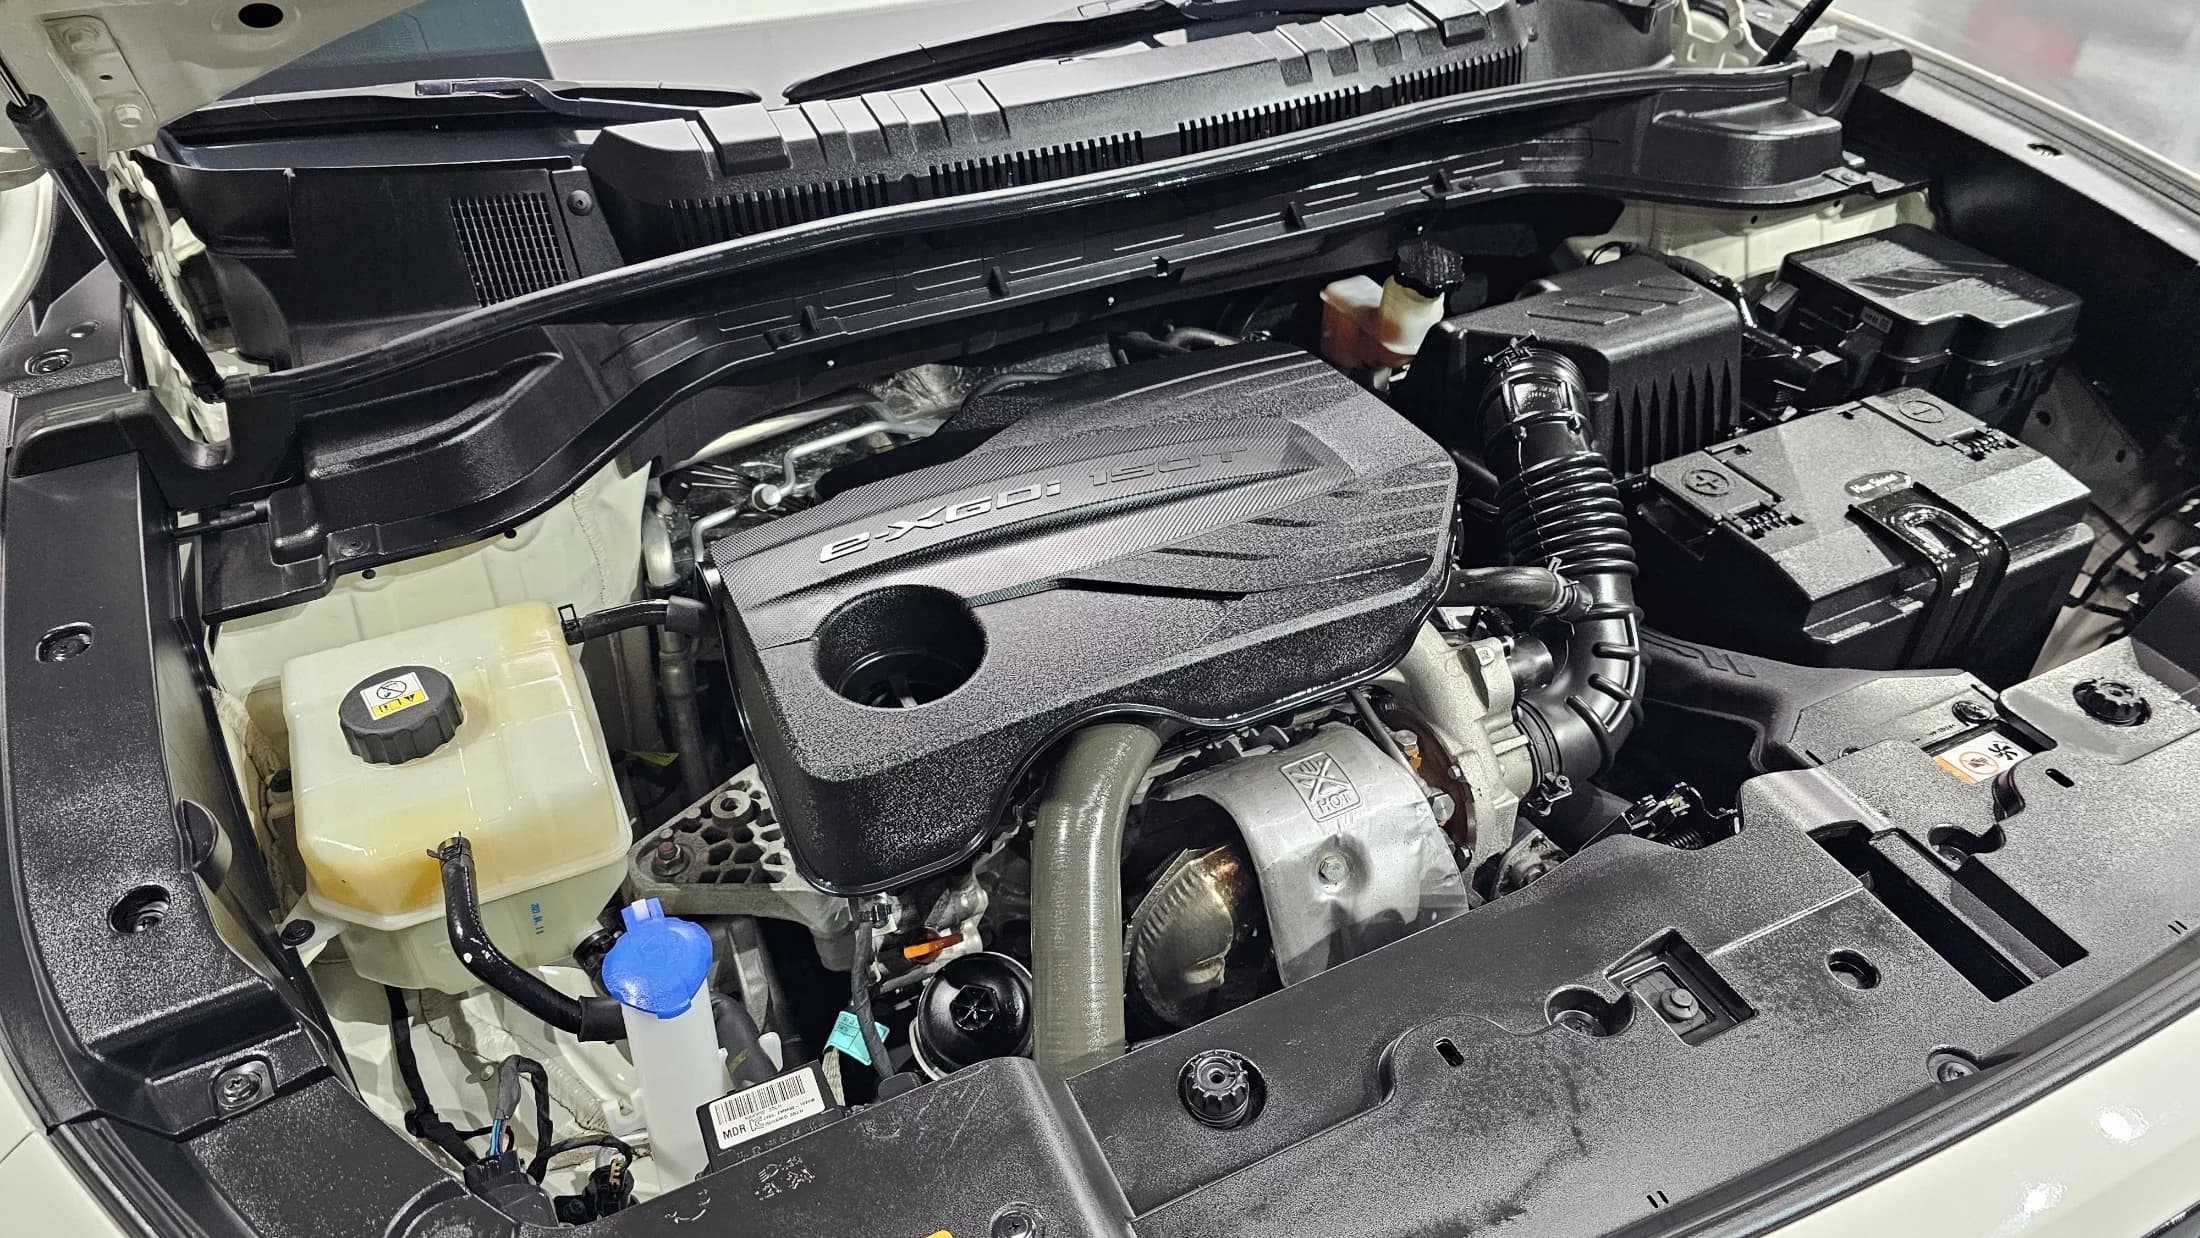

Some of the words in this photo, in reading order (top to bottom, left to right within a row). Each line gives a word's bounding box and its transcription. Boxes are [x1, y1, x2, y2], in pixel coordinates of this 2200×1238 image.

[1088, 445, 1248, 487] 150T
[1316, 788, 1351, 815] HOT
[722, 1123, 747, 1141] MDR
